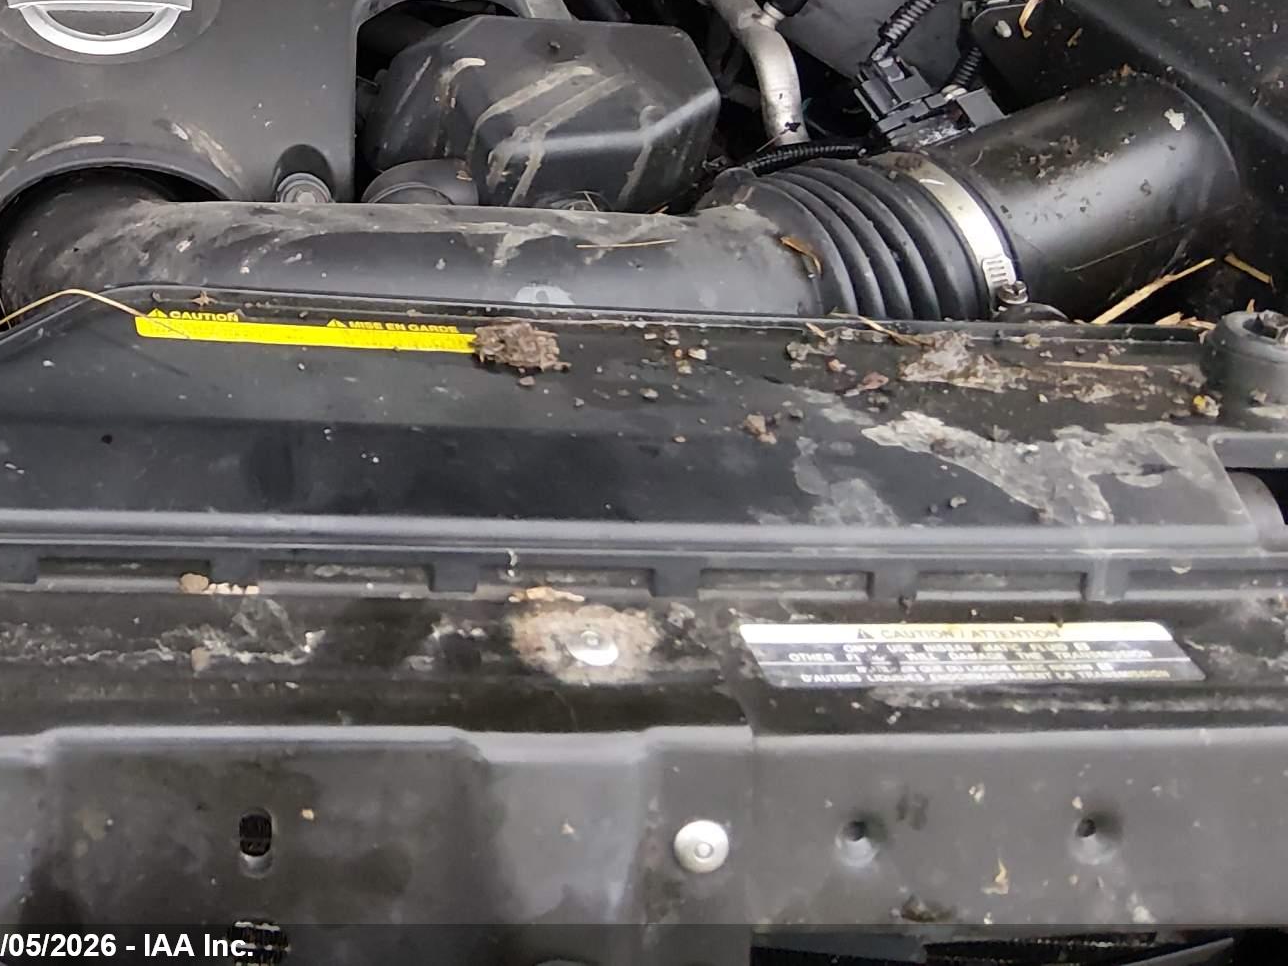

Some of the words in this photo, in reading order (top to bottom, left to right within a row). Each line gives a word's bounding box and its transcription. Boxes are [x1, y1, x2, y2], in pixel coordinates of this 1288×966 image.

[169, 310, 239, 323] CAUTION
[348, 320, 384, 331] MISE
[385, 322, 407, 332] EN
[407, 323, 460, 334] GARDE
[881, 629, 954, 640] CAUTION
[971, 629, 1061, 639] ATTENTION
[788, 652, 836, 663] OTHER
[905, 653, 939, 662] WILL
[1015, 651, 1046, 661] THE
[1053, 650, 1153, 660] TRANSMISSION
[800, 673, 862, 684] D'AUTRES
